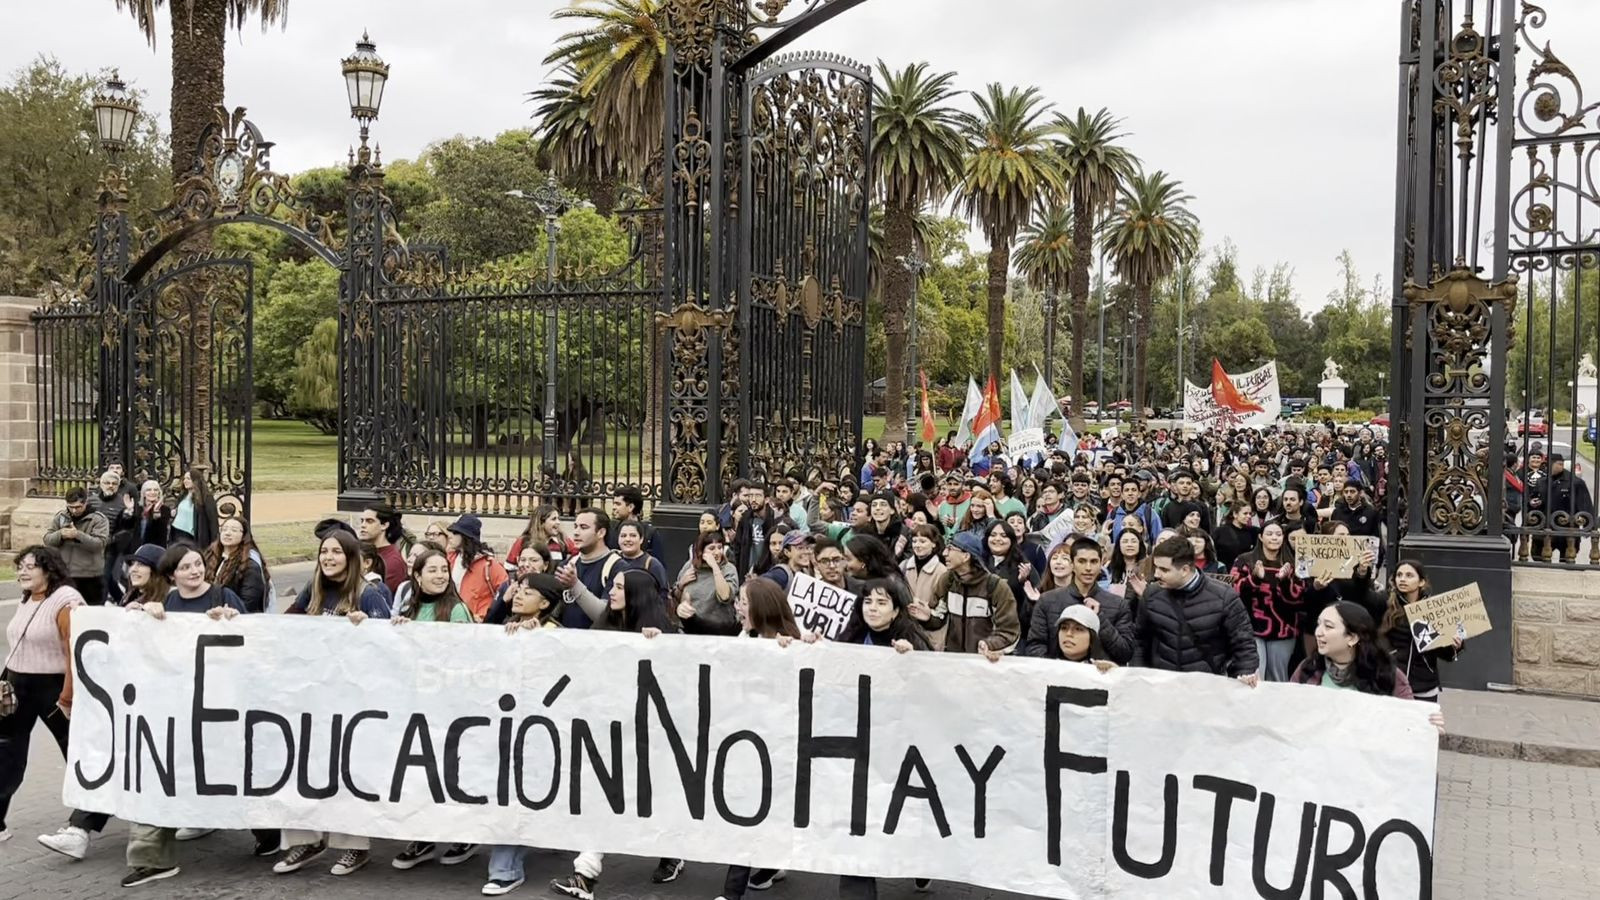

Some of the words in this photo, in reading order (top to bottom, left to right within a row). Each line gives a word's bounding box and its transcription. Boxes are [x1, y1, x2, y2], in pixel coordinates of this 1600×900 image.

[1297, 537, 1307, 545] LA
[1297, 546, 1308, 557] SE
[791, 577, 815, 603] LA
[818, 586, 854, 617] EDUC
[1408, 604, 1422, 615] LA
[1422, 612, 1435, 622] NO
[1435, 610, 1446, 618] ES
[1446, 606, 1458, 615] UN
[1431, 621, 1444, 631] ES
[1446, 615, 1461, 626] UN
[794, 668, 1006, 839] HAY
[1043, 685, 1434, 900] FUTURO
